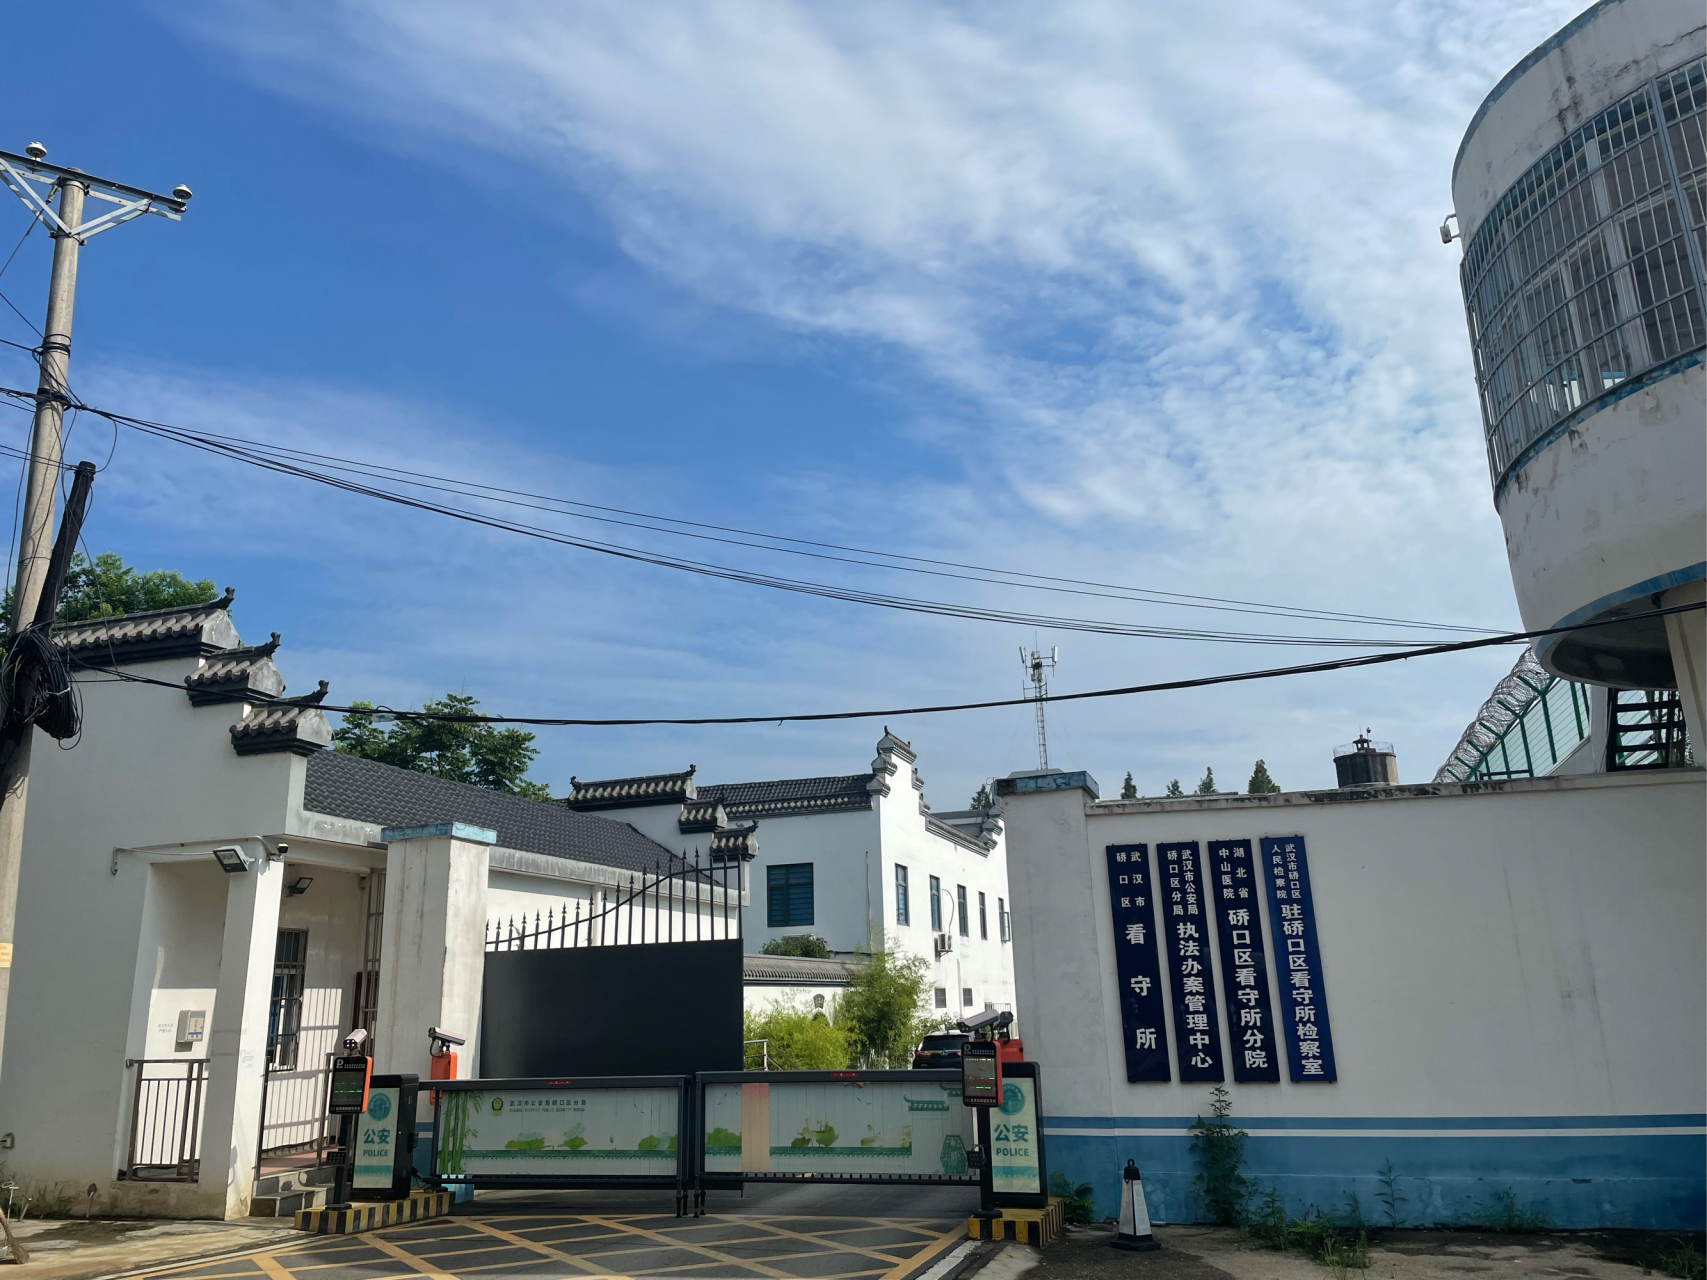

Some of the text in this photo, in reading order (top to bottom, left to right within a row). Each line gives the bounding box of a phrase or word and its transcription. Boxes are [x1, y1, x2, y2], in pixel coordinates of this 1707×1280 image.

[1116, 852, 1131, 908] 硚口区
[1130, 851, 1145, 907] 武汉市
[1167, 850, 1184, 916] 硚口区分局
[1181, 849, 1199, 915] 武汉市公安局
[1218, 847, 1235, 899] 中山医院
[1233, 847, 1249, 899] 湖北省
[1271, 844, 1288, 899] 人民检察院
[1284, 843, 1302, 899] 武汉市硚口区
[1125, 923, 1157, 1050] 看守所
[1176, 922, 1213, 1068] 执法办案管理中心
[1227, 908, 1268, 1068] 硚口区看守所分院
[1280, 903, 1324, 1075] 驻硚口区看守所检察室
[362, 1149, 388, 1157] POLICE
[363, 1128, 390, 1145] 公安
[993, 1123, 1029, 1143] 公安
[996, 1147, 1029, 1157] POLICE
